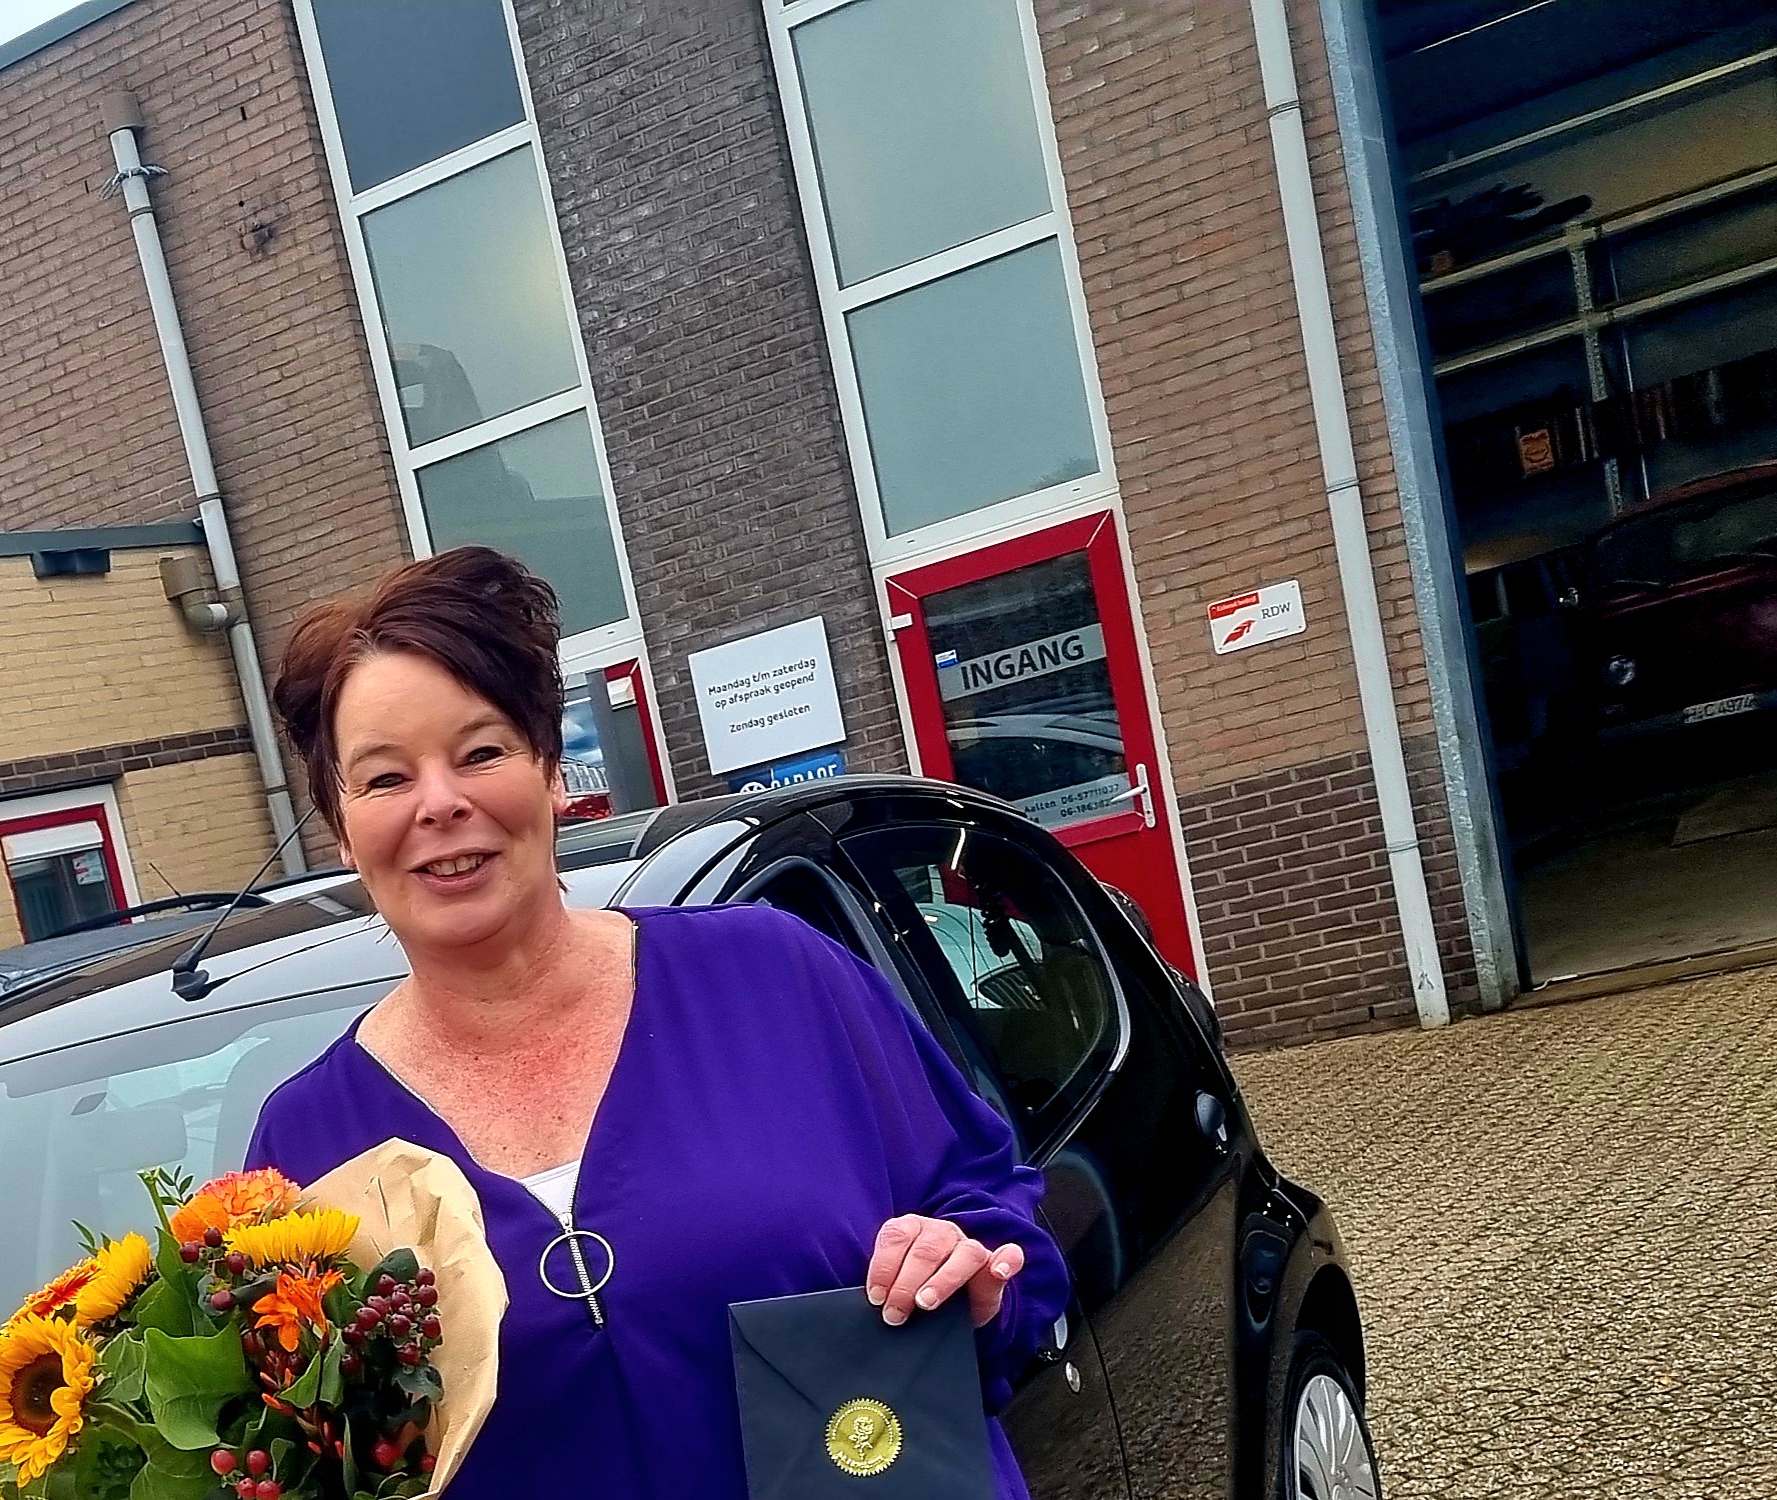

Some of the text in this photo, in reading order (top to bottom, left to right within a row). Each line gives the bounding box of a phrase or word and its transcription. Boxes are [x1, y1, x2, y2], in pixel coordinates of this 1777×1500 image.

[1261, 602, 1291, 619] RDW
[708, 658, 816, 695] Maandag t/m zaterdag
[960, 634, 1085, 691] INGANG
[714, 672, 815, 709] op afspraak geopend
[729, 704, 811, 733] Zondag gesloten
